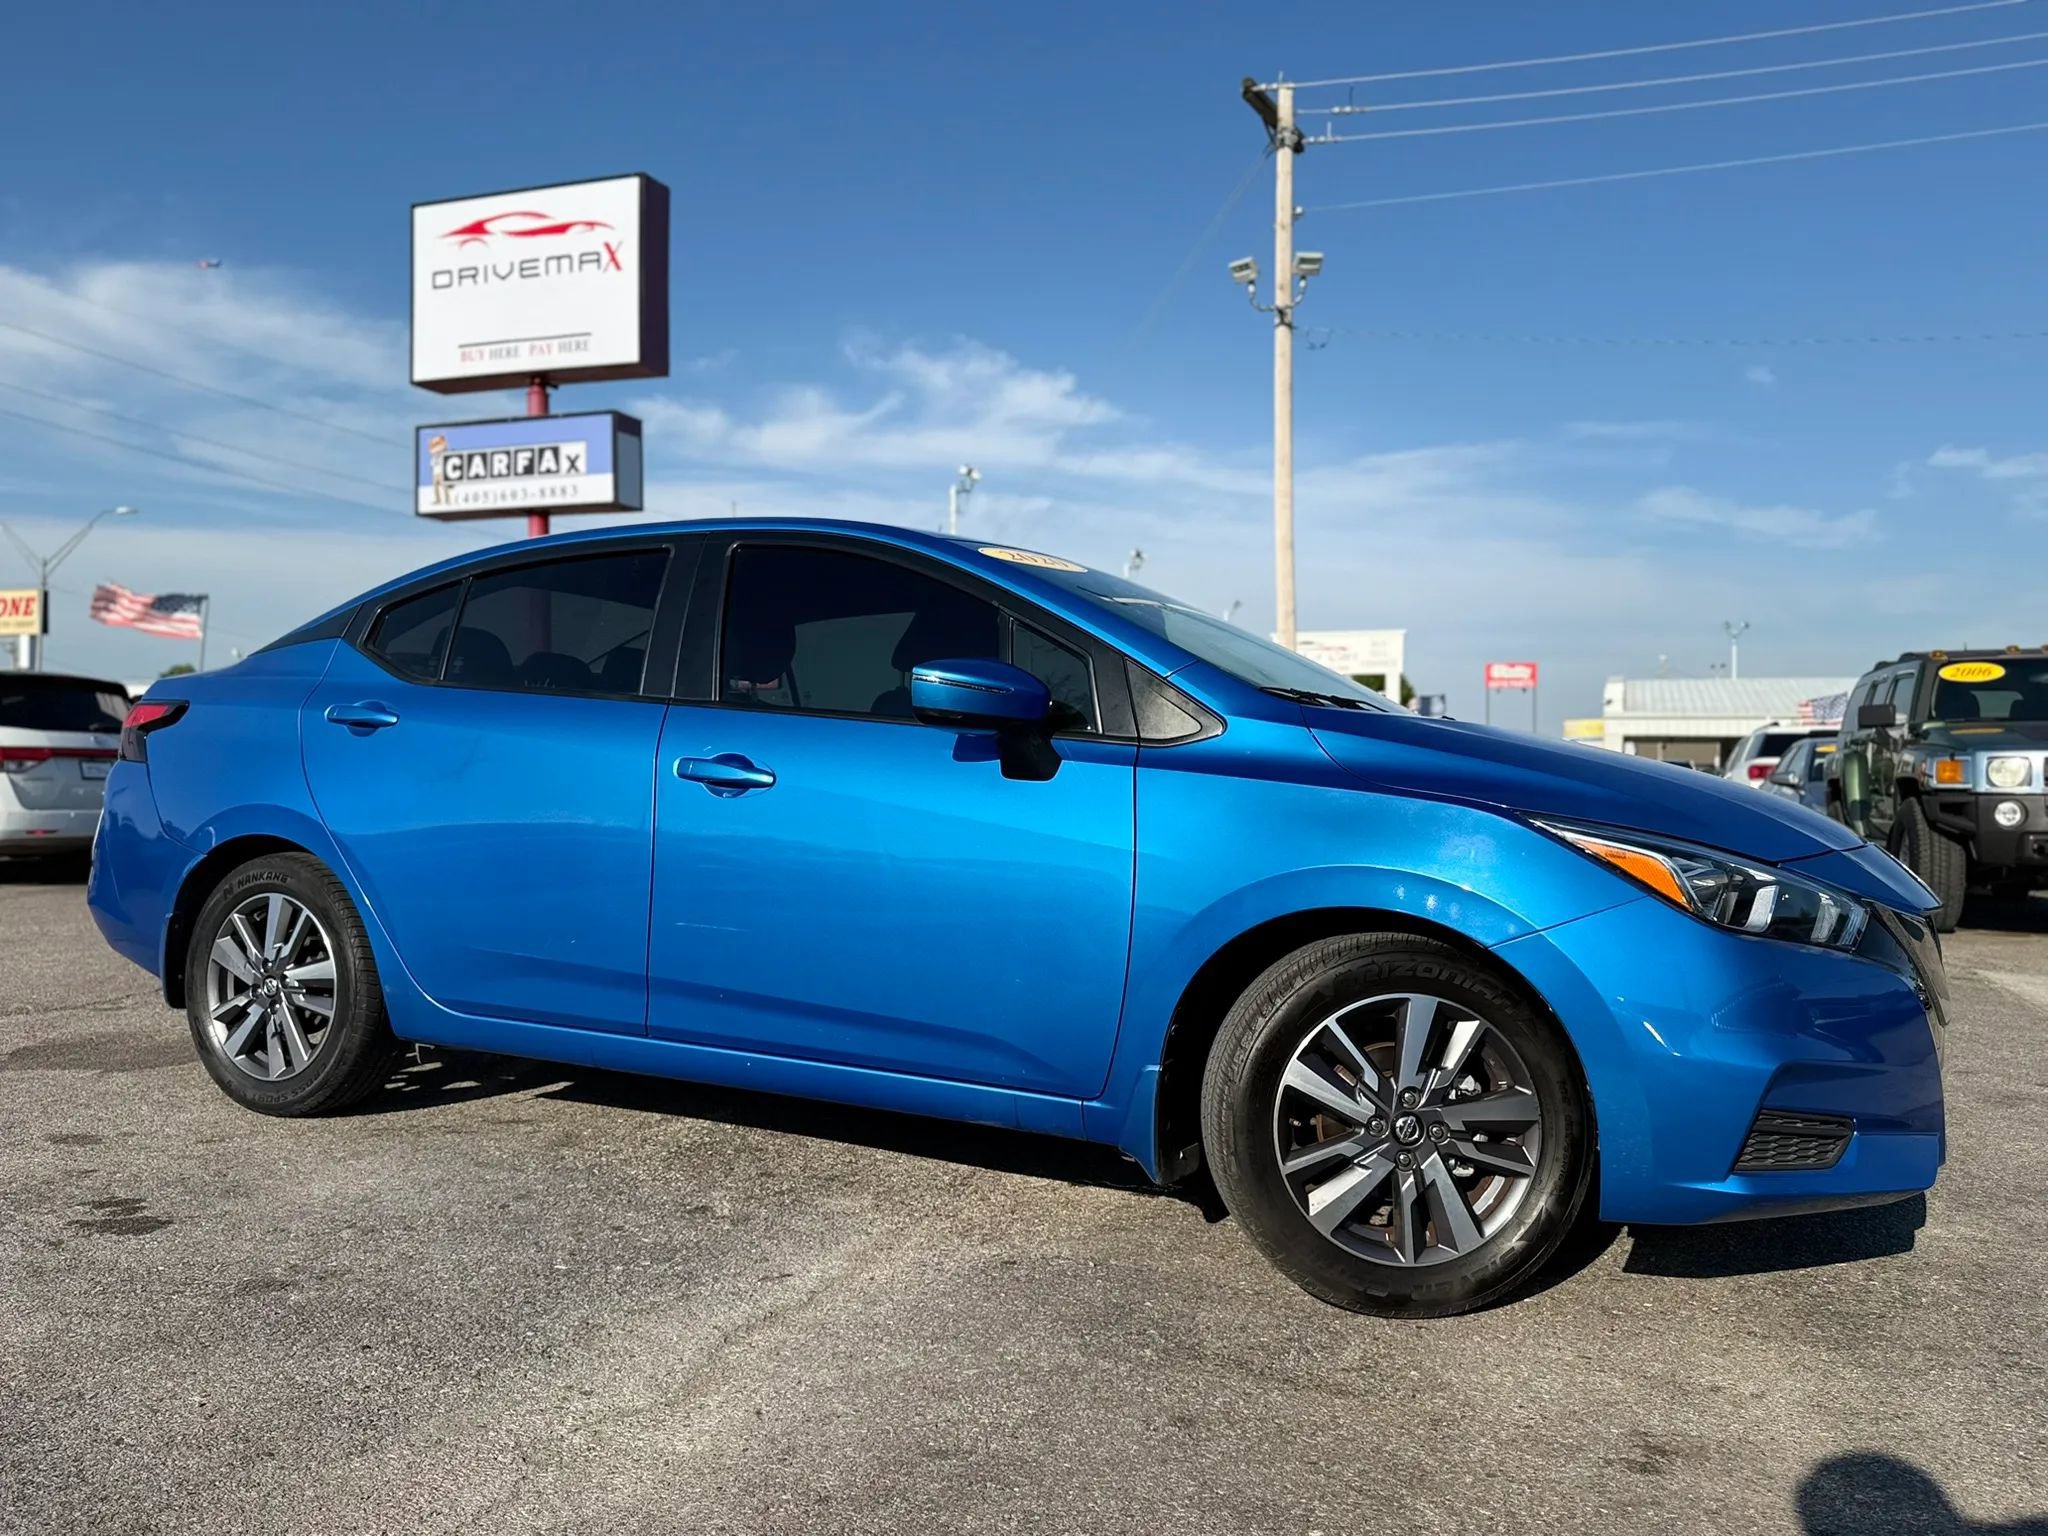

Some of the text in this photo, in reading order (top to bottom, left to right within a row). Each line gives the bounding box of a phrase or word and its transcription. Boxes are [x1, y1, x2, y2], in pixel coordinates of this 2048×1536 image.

[432, 240, 622, 290] DRIVEMAX
[460, 339, 589, 362] BUY HERE PAY HERE
[444, 447, 582, 481] CARFAX
[1950, 666, 1992, 678] 2006
[237, 871, 289, 889] NANKANG
